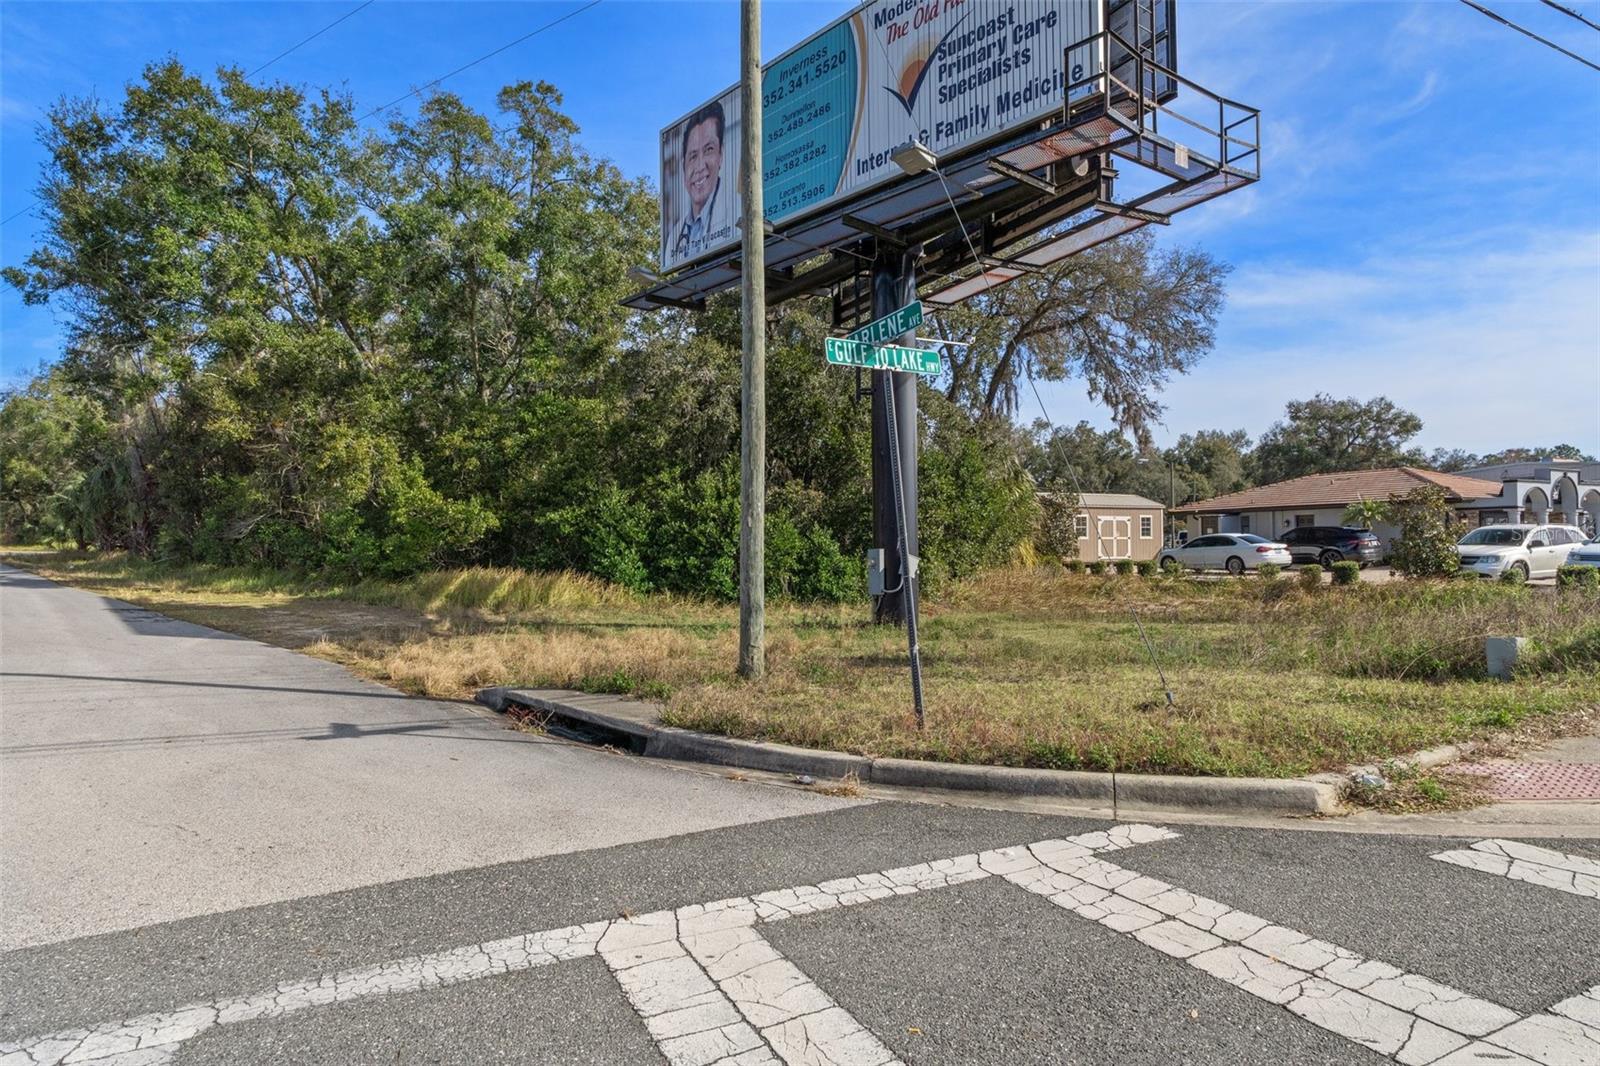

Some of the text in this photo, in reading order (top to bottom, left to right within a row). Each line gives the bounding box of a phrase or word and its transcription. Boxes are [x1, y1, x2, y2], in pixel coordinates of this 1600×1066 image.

[874, 0, 923, 29] Moder
[887, 21, 910, 45] The
[913, 0, 939, 29] Old
[938, 6, 1015, 61] Suncoast
[779, 46, 828, 82] Inverness
[939, 10, 1057, 83] Primary Care
[763, 50, 846, 108] 352.341.5520
[939, 47, 1031, 104] Specialists
[857, 134, 913, 176] Inter
[935, 103, 990, 142] Family
[848, 311, 906, 344] ARLENE
[828, 340, 834, 351] E
[835, 341, 868, 364] GULF
[873, 346, 888, 366] TO
[893, 347, 925, 371] LAKE
